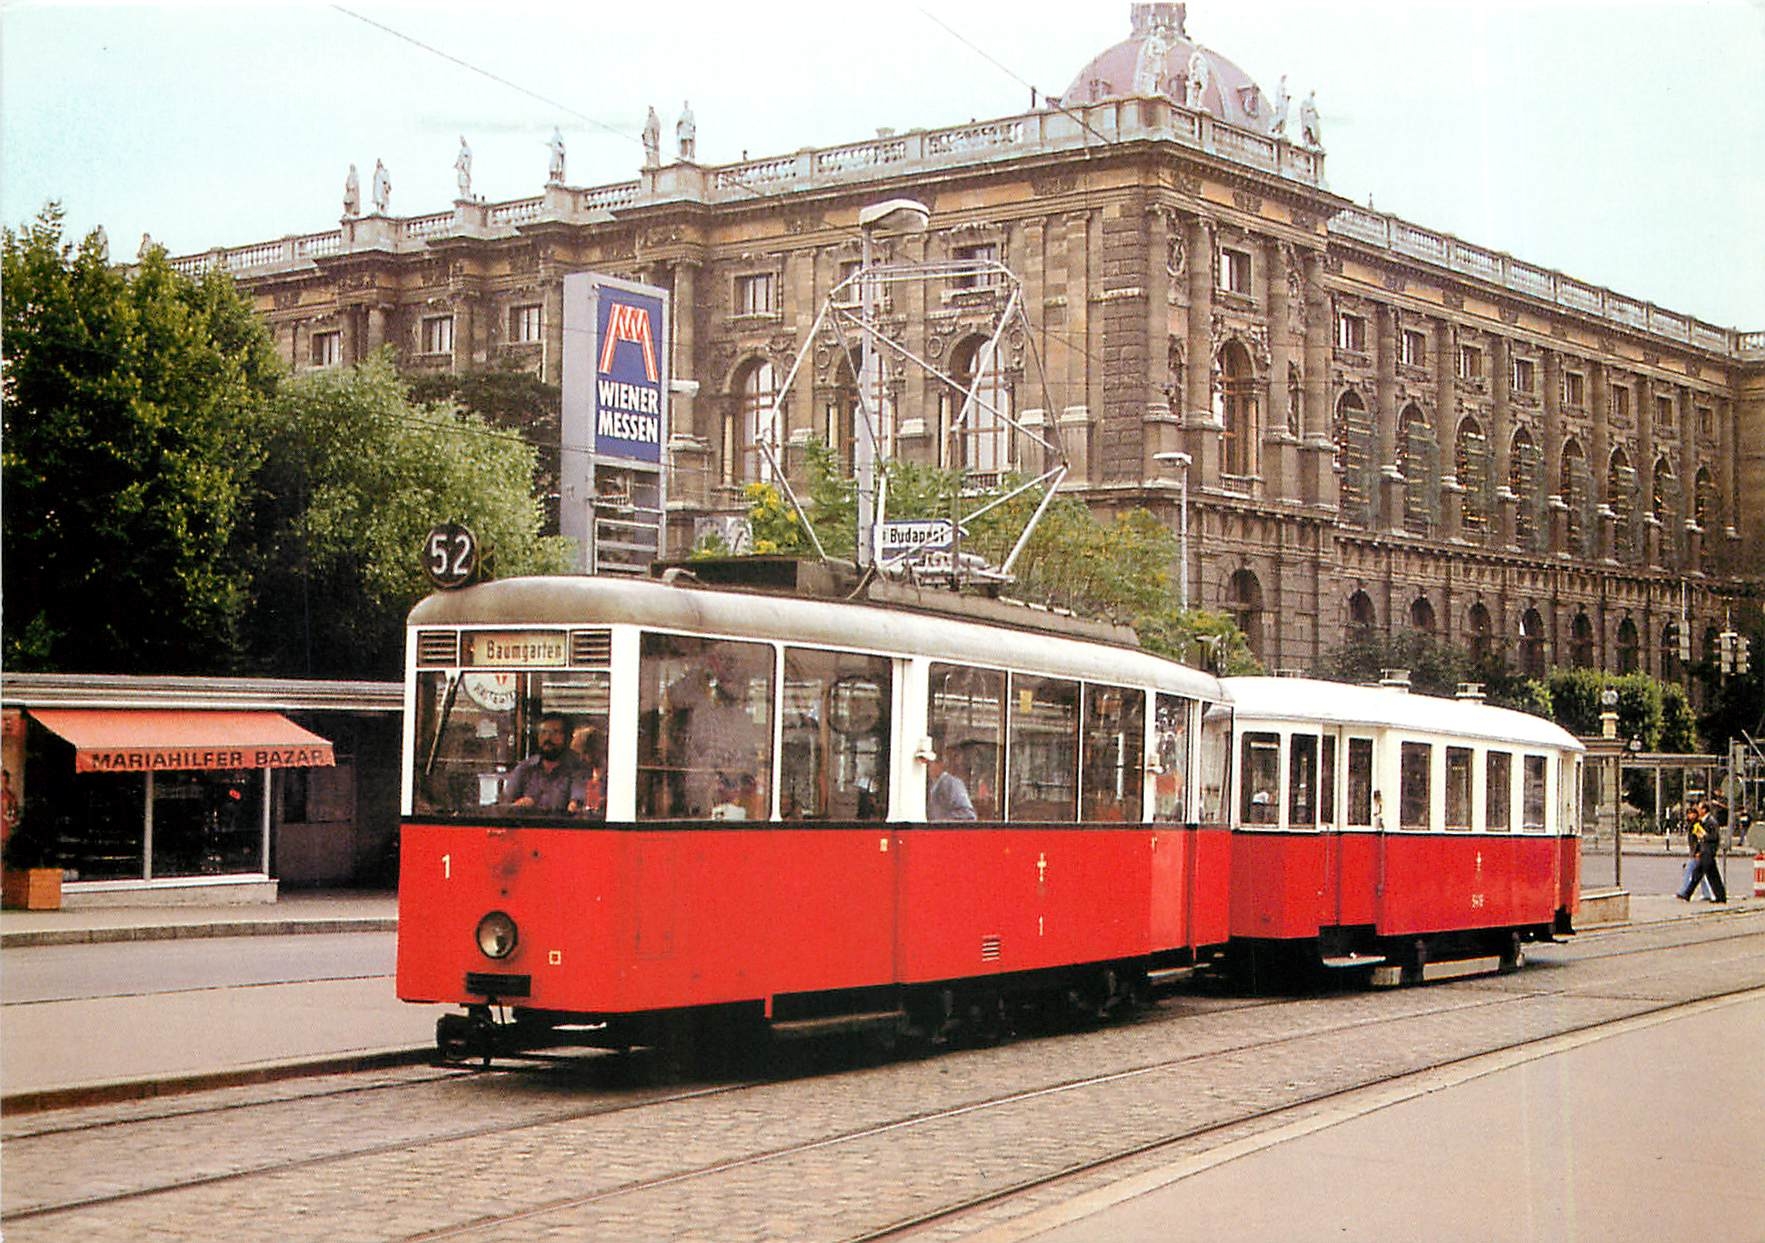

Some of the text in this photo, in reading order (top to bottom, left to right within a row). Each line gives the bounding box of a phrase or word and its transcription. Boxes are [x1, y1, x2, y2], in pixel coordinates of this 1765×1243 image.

[598, 380, 659, 415] WIENER
[598, 409, 659, 444] MESSEN
[890, 527, 944, 545] Budapest
[431, 534, 470, 575] 52
[486, 639, 562, 663] Baumgarten
[92, 751, 243, 769] MARIAHILFER
[441, 853, 451, 881] 1
